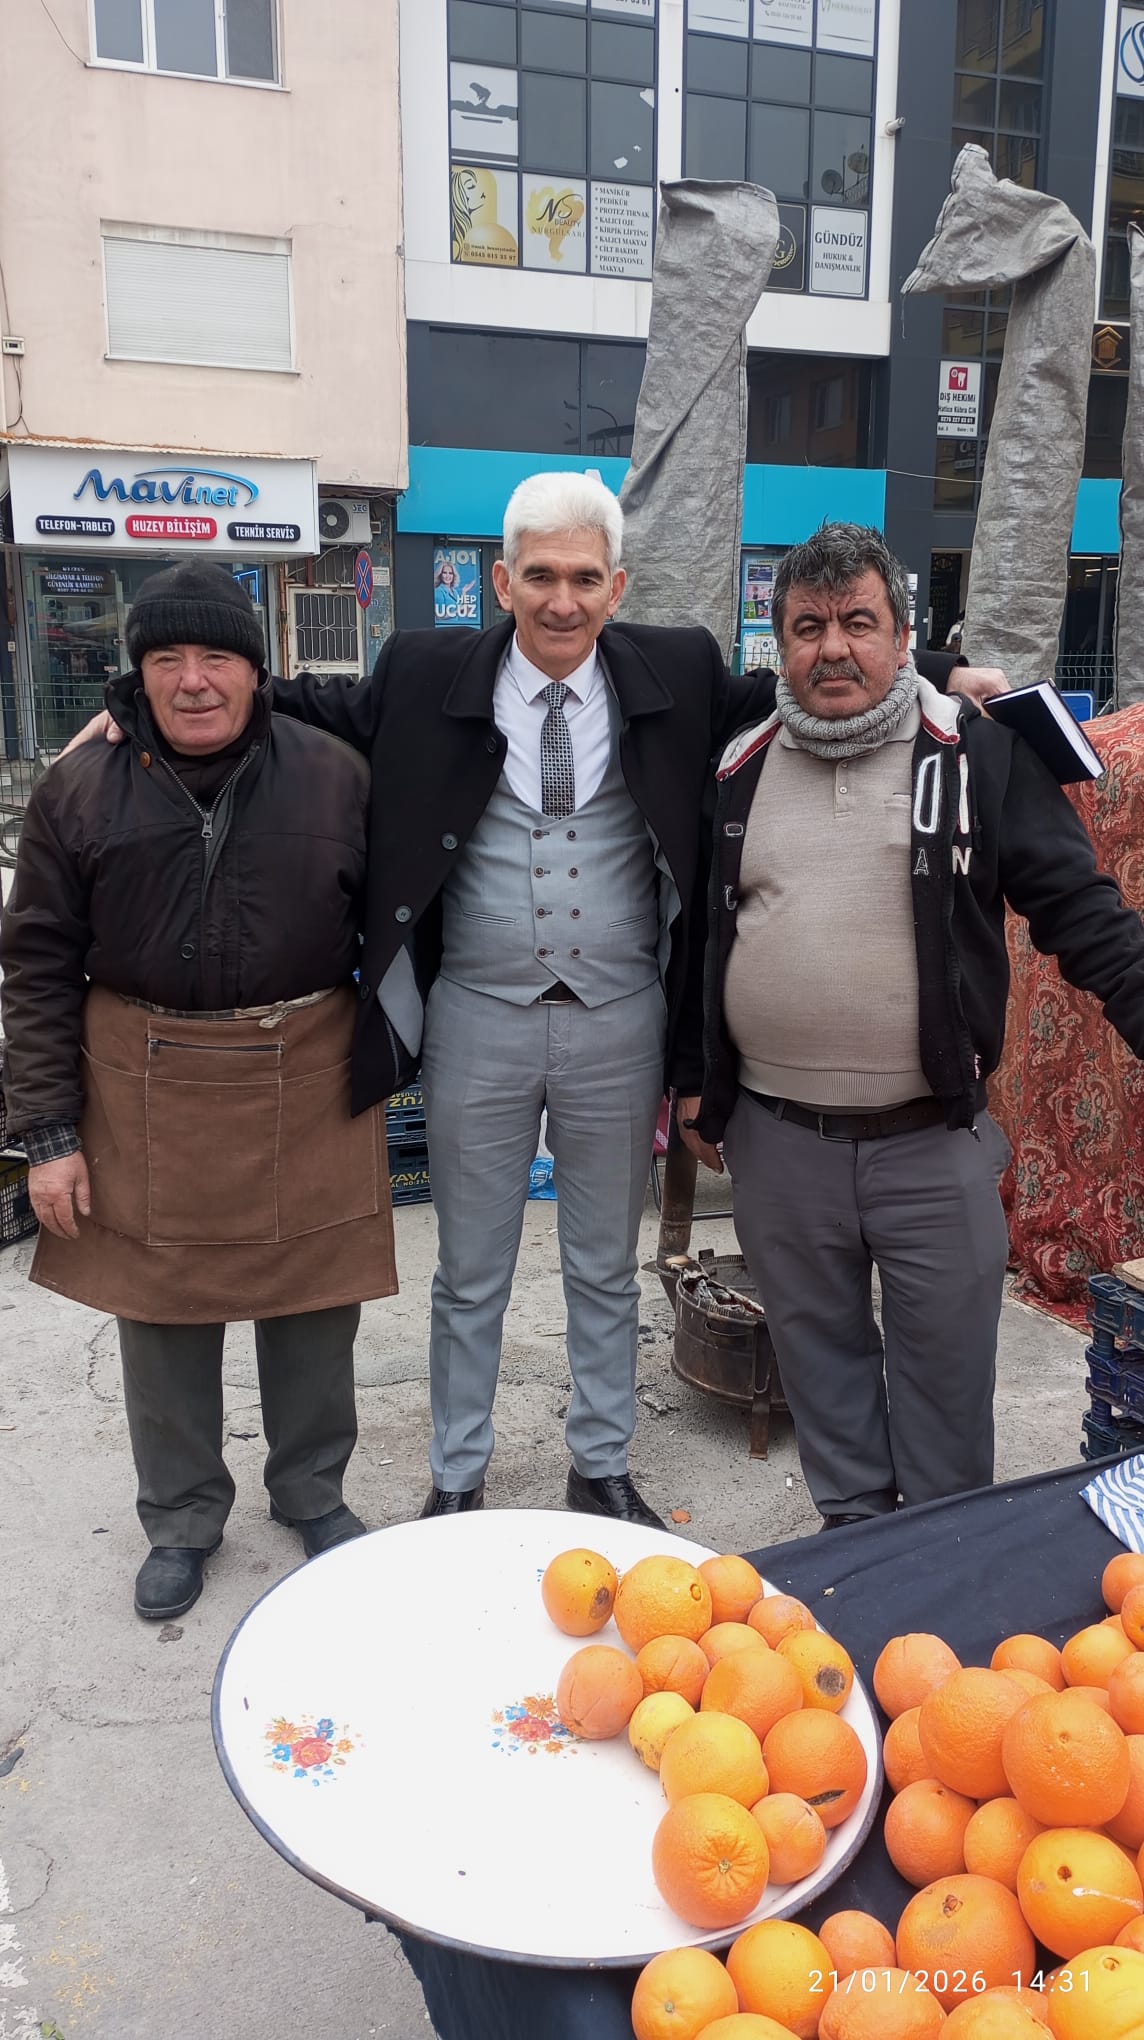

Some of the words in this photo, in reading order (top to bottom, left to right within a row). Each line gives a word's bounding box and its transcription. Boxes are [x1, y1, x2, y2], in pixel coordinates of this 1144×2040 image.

[600, 187, 630, 197] MANİKÜR
[600, 197, 628, 206] PEDİKÜR
[600, 207, 625, 216] PROTEZ
[626, 209, 649, 218] TIRNAK
[554, 219, 580, 228] BEAUTY
[600, 217, 620, 225] KALICI
[600, 225, 621, 234] KİRPİK
[623, 228, 649, 237] LİFTİNG
[600, 236, 620, 244] KALICI
[622, 238, 647, 247] MAKYAJ
[815, 229, 863, 247] GÜNDÜZ
[600, 244, 613, 253] CİLT
[615, 246, 639, 255] BAKIMI
[600, 255, 644, 265] PROFESYONEL
[823, 252, 847, 262] HUKUK
[848, 254, 854, 262] &
[600, 264, 625, 273] MAKYAJ
[815, 262, 861, 273] DANIŞMANLIK
[940, 392, 951, 403] DİŞ
[39, 519, 112, 532] TELEFON-TABLET
[167, 518, 211, 537] BİLİŞİM
[266, 526, 295, 539] SERVİS
[456, 594, 477, 604] HEP
[435, 603, 477, 618] UCUZ
[952, 845, 972, 875] N
